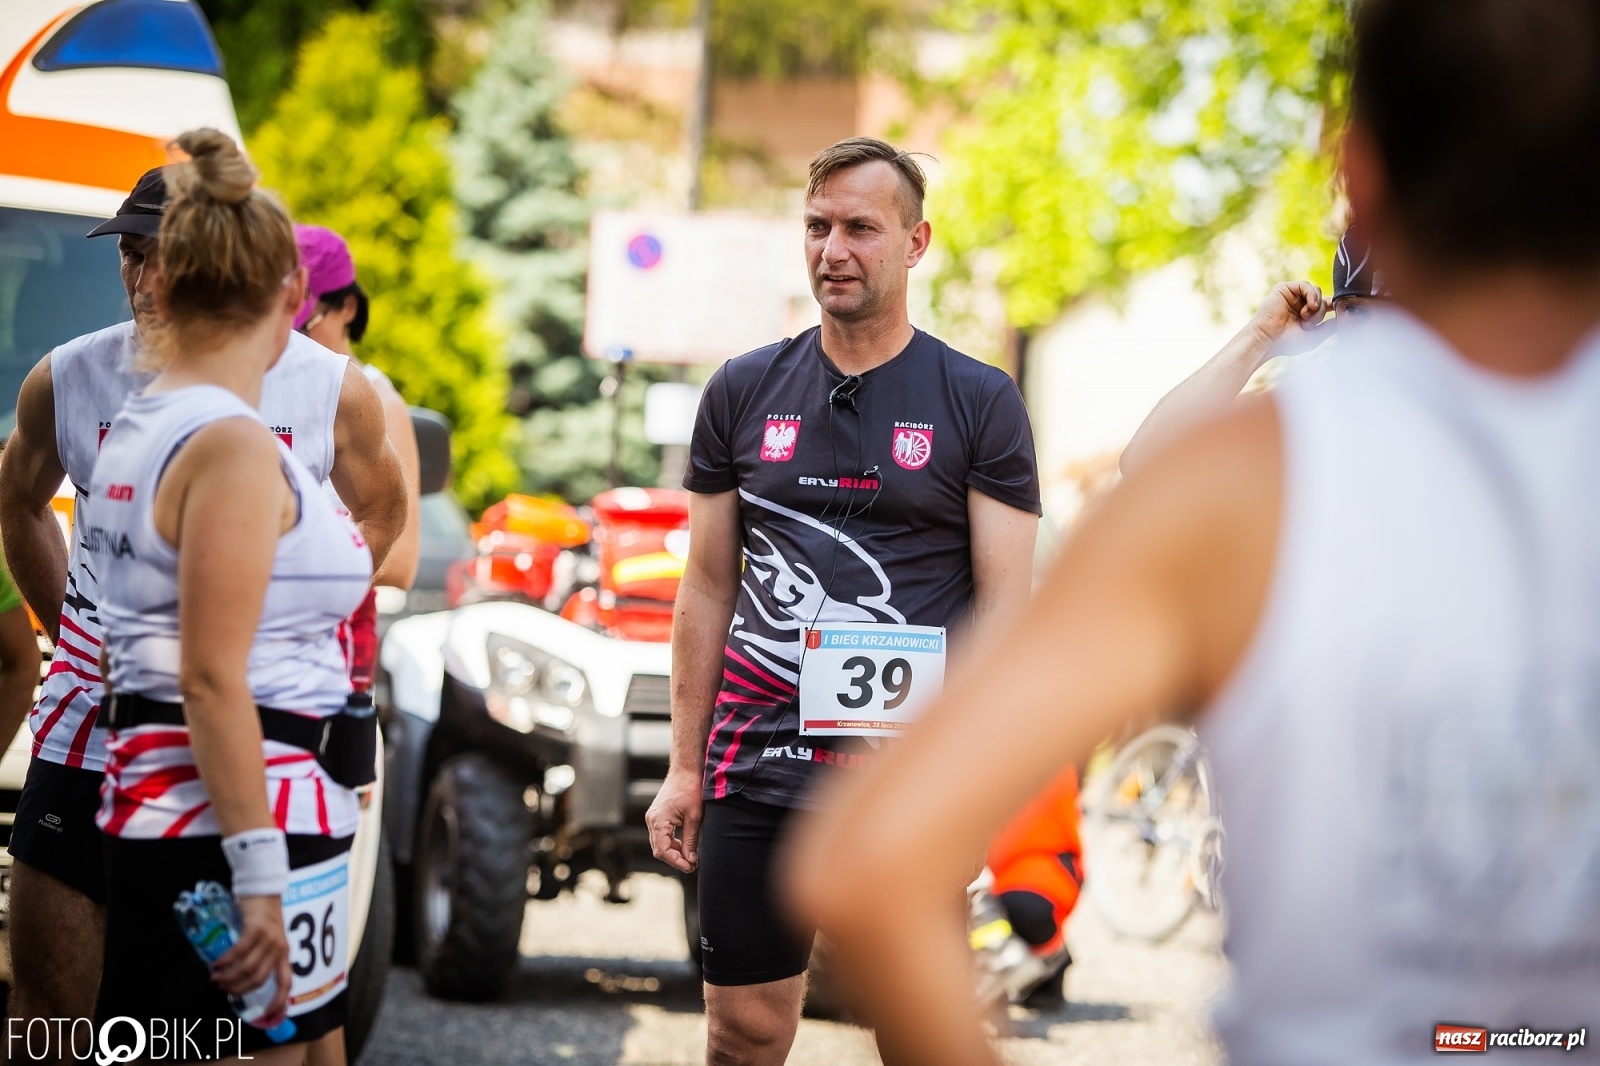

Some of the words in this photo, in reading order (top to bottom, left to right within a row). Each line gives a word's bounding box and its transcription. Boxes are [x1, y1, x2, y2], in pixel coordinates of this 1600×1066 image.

[894, 421, 934, 430] RACIBÓRZ
[823, 634, 829, 645] I
[830, 634, 859, 646] BIEG
[861, 634, 939, 650] KRZANOWICKI
[836, 655, 913, 710] 39
[836, 720, 872, 729] Krzanowice,
[288, 902, 335, 978] 36
